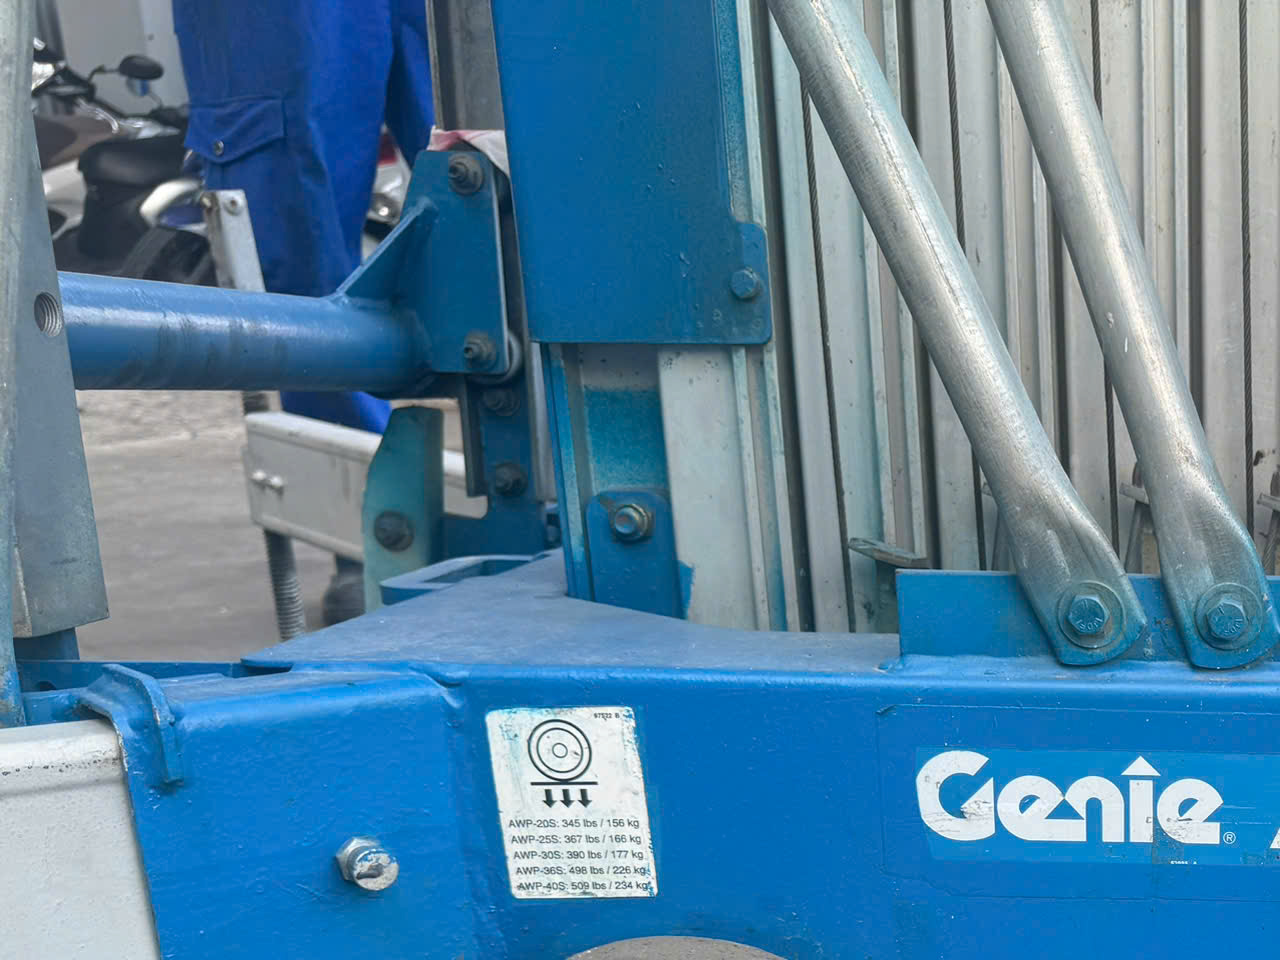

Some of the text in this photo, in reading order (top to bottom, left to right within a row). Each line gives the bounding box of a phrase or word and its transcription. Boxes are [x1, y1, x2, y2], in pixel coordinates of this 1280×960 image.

[916, 750, 1220, 844] Genie
[508, 819, 560, 828] AWP-20S:
[561, 819, 581, 828] 345
[583, 819, 598, 828] lbs
[607, 819, 625, 828] 156
[627, 818, 640, 829] kg
[511, 835, 562, 844] AWP-25S:
[564, 835, 583, 844] 367
[585, 835, 601, 844] lbs
[609, 835, 627, 844] 166
[629, 834, 642, 845] kg
[513, 850, 564, 860] AWP-30S:
[566, 850, 586, 860] 390
[587, 850, 603, 860] lbs
[611, 850, 629, 860] 177
[631, 850, 644, 861] kg
[515, 866, 567, 876] AWP-36S:
[568, 866, 588, 876] 498
[590, 866, 605, 876] lbs
[612, 866, 632, 876] 226
[633, 865, 646, 876] kg
[518, 881, 569, 891] AWP-40S:
[571, 881, 590, 891] 509
[592, 881, 607, 891] lbs
[614, 881, 633, 891] 234
[635, 880, 648, 892] kg
